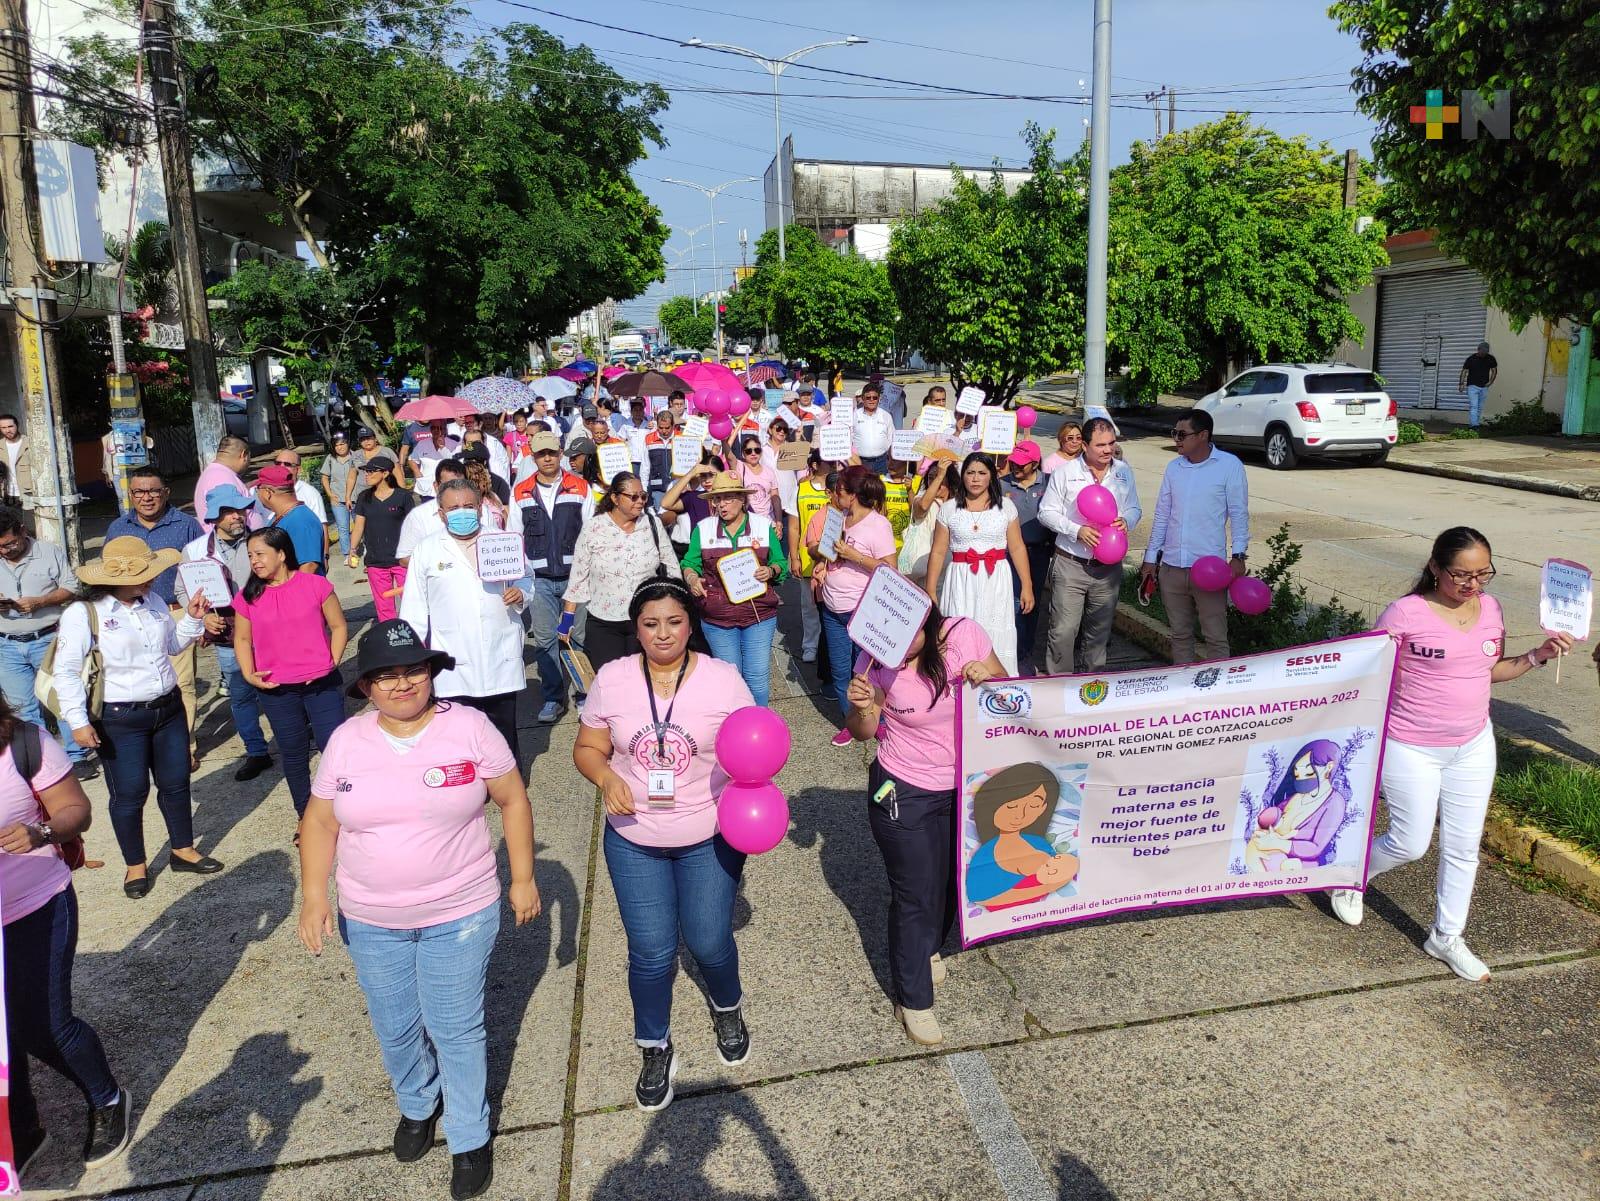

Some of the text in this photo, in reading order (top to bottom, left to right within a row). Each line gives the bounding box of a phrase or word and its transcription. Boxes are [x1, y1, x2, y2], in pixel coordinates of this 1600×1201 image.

[492, 546, 501, 554] de
[483, 557, 519, 566] digestión
[494, 568, 500, 576] el
[502, 568, 522, 576] bebé
[1550, 576, 1578, 590] Previene
[882, 584, 913, 613] Previene
[904, 587, 928, 609] materna
[874, 595, 910, 626] sobrepeso
[865, 622, 897, 649] obesidad
[862, 634, 888, 657] infantil
[1286, 652, 1342, 666] SESVER
[1228, 665, 1247, 674] SS
[1115, 680, 1163, 691] GOBIERNO
[1117, 675, 1169, 684] VERACRUZ
[1115, 686, 1169, 698] DEL ESTADO
[984, 689, 1360, 739] SEMANA MUNDIAL DE LA LACTANCIA MATERNA 2023
[1059, 716, 1294, 750] HOSPITAL REGIONAL DE COATZACOALCOS
[1096, 732, 1257, 759] DR. VALENTIN GOMEZ FARIAS
[1118, 778, 1215, 797] La lactancia
[1112, 795, 1215, 814] materna es la
[1100, 810, 1220, 831] mejor fuente de
[1091, 823, 1226, 844] nutrientes para tu
[1133, 845, 1170, 857] bebé
[1012, 876, 1308, 923] Semana mundial de lactancia materna del 01 al 07 de agosto 2023
